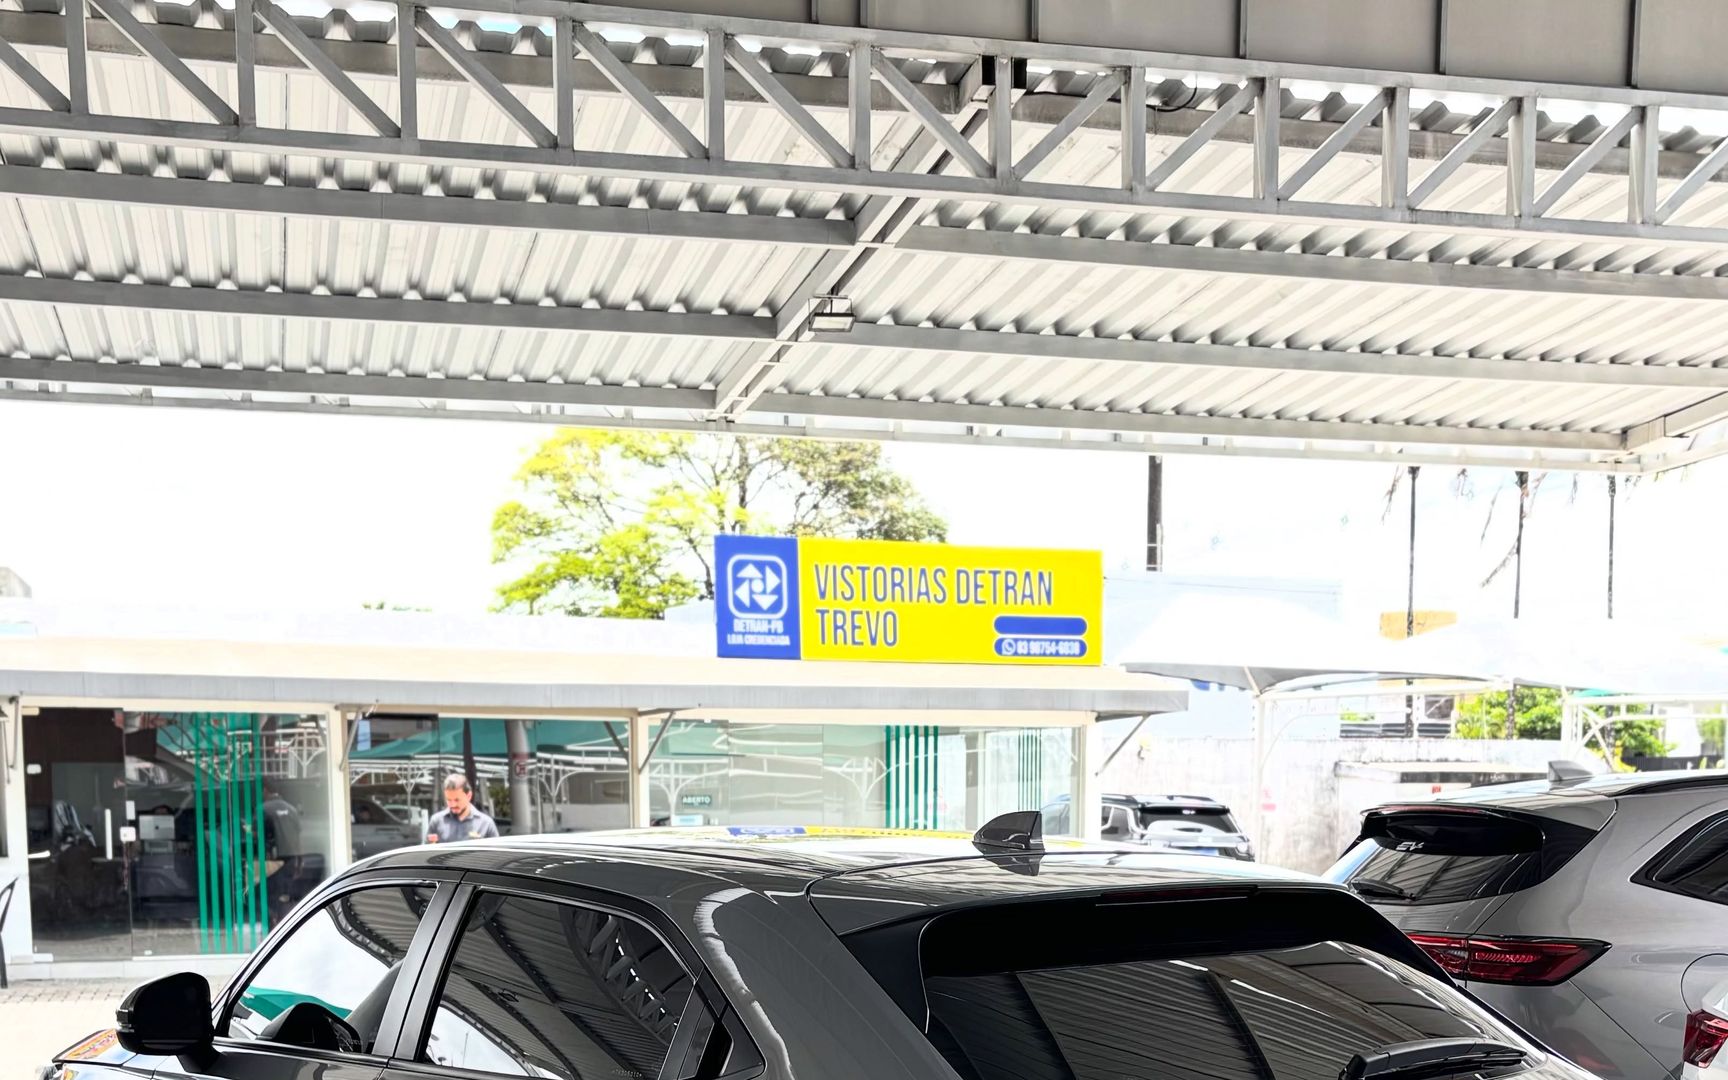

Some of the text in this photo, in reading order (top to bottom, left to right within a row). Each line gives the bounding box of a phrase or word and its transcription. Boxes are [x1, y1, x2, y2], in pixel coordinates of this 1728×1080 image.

[814, 564, 1052, 606] VISTORIAS DETRAN
[815, 609, 897, 646] TREVO
